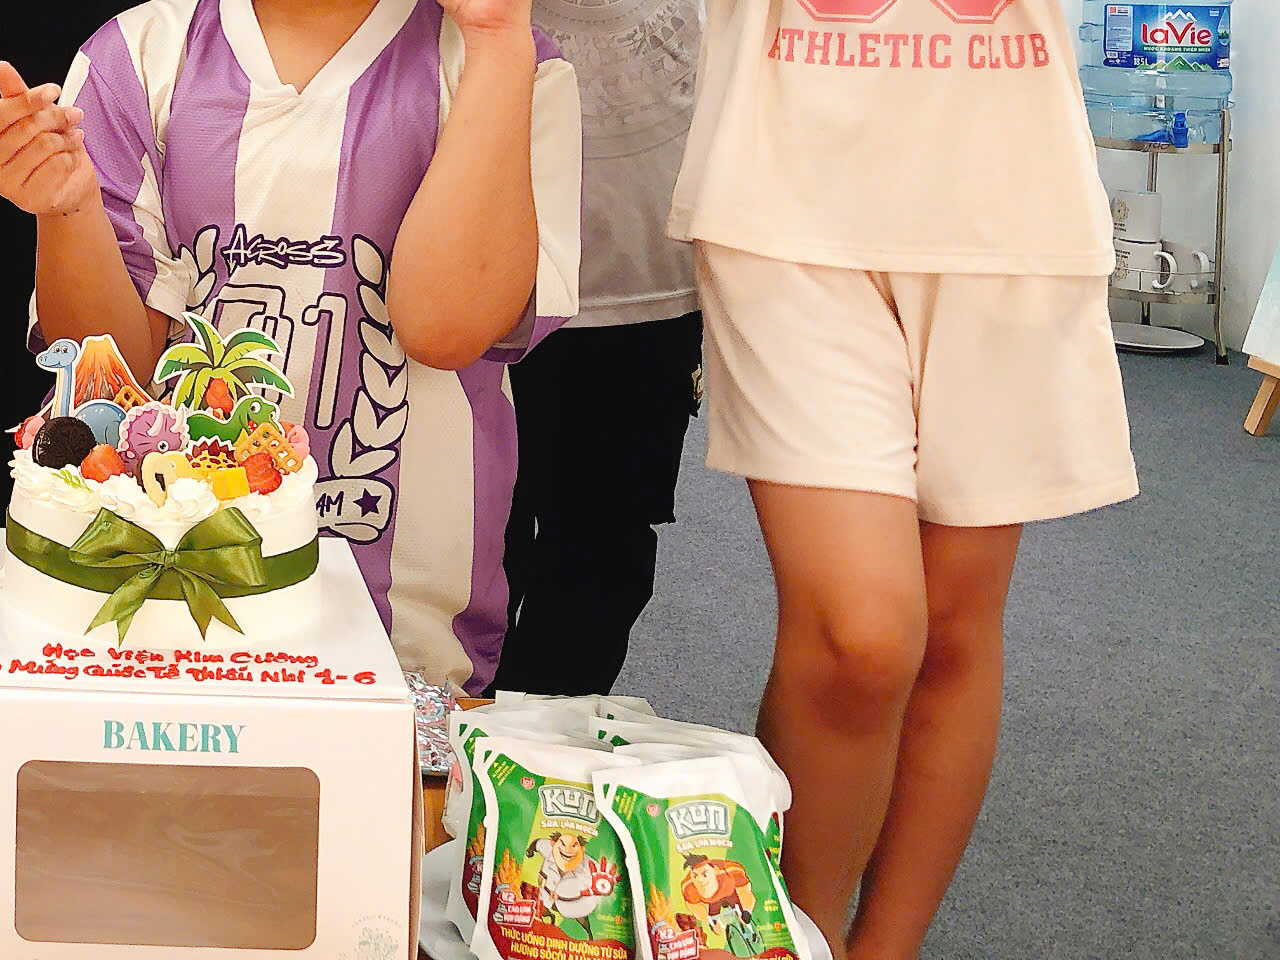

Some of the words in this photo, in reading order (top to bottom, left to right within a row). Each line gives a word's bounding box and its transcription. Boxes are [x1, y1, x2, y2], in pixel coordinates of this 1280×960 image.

[767, 25, 952, 70] ATHLETIC
[967, 32, 1050, 70] CLUB
[221, 223, 347, 277] ACROSS
[316, 491, 345, 517] AM
[173, 649, 224, 663] Kim
[102, 719, 247, 754] BAKERY
